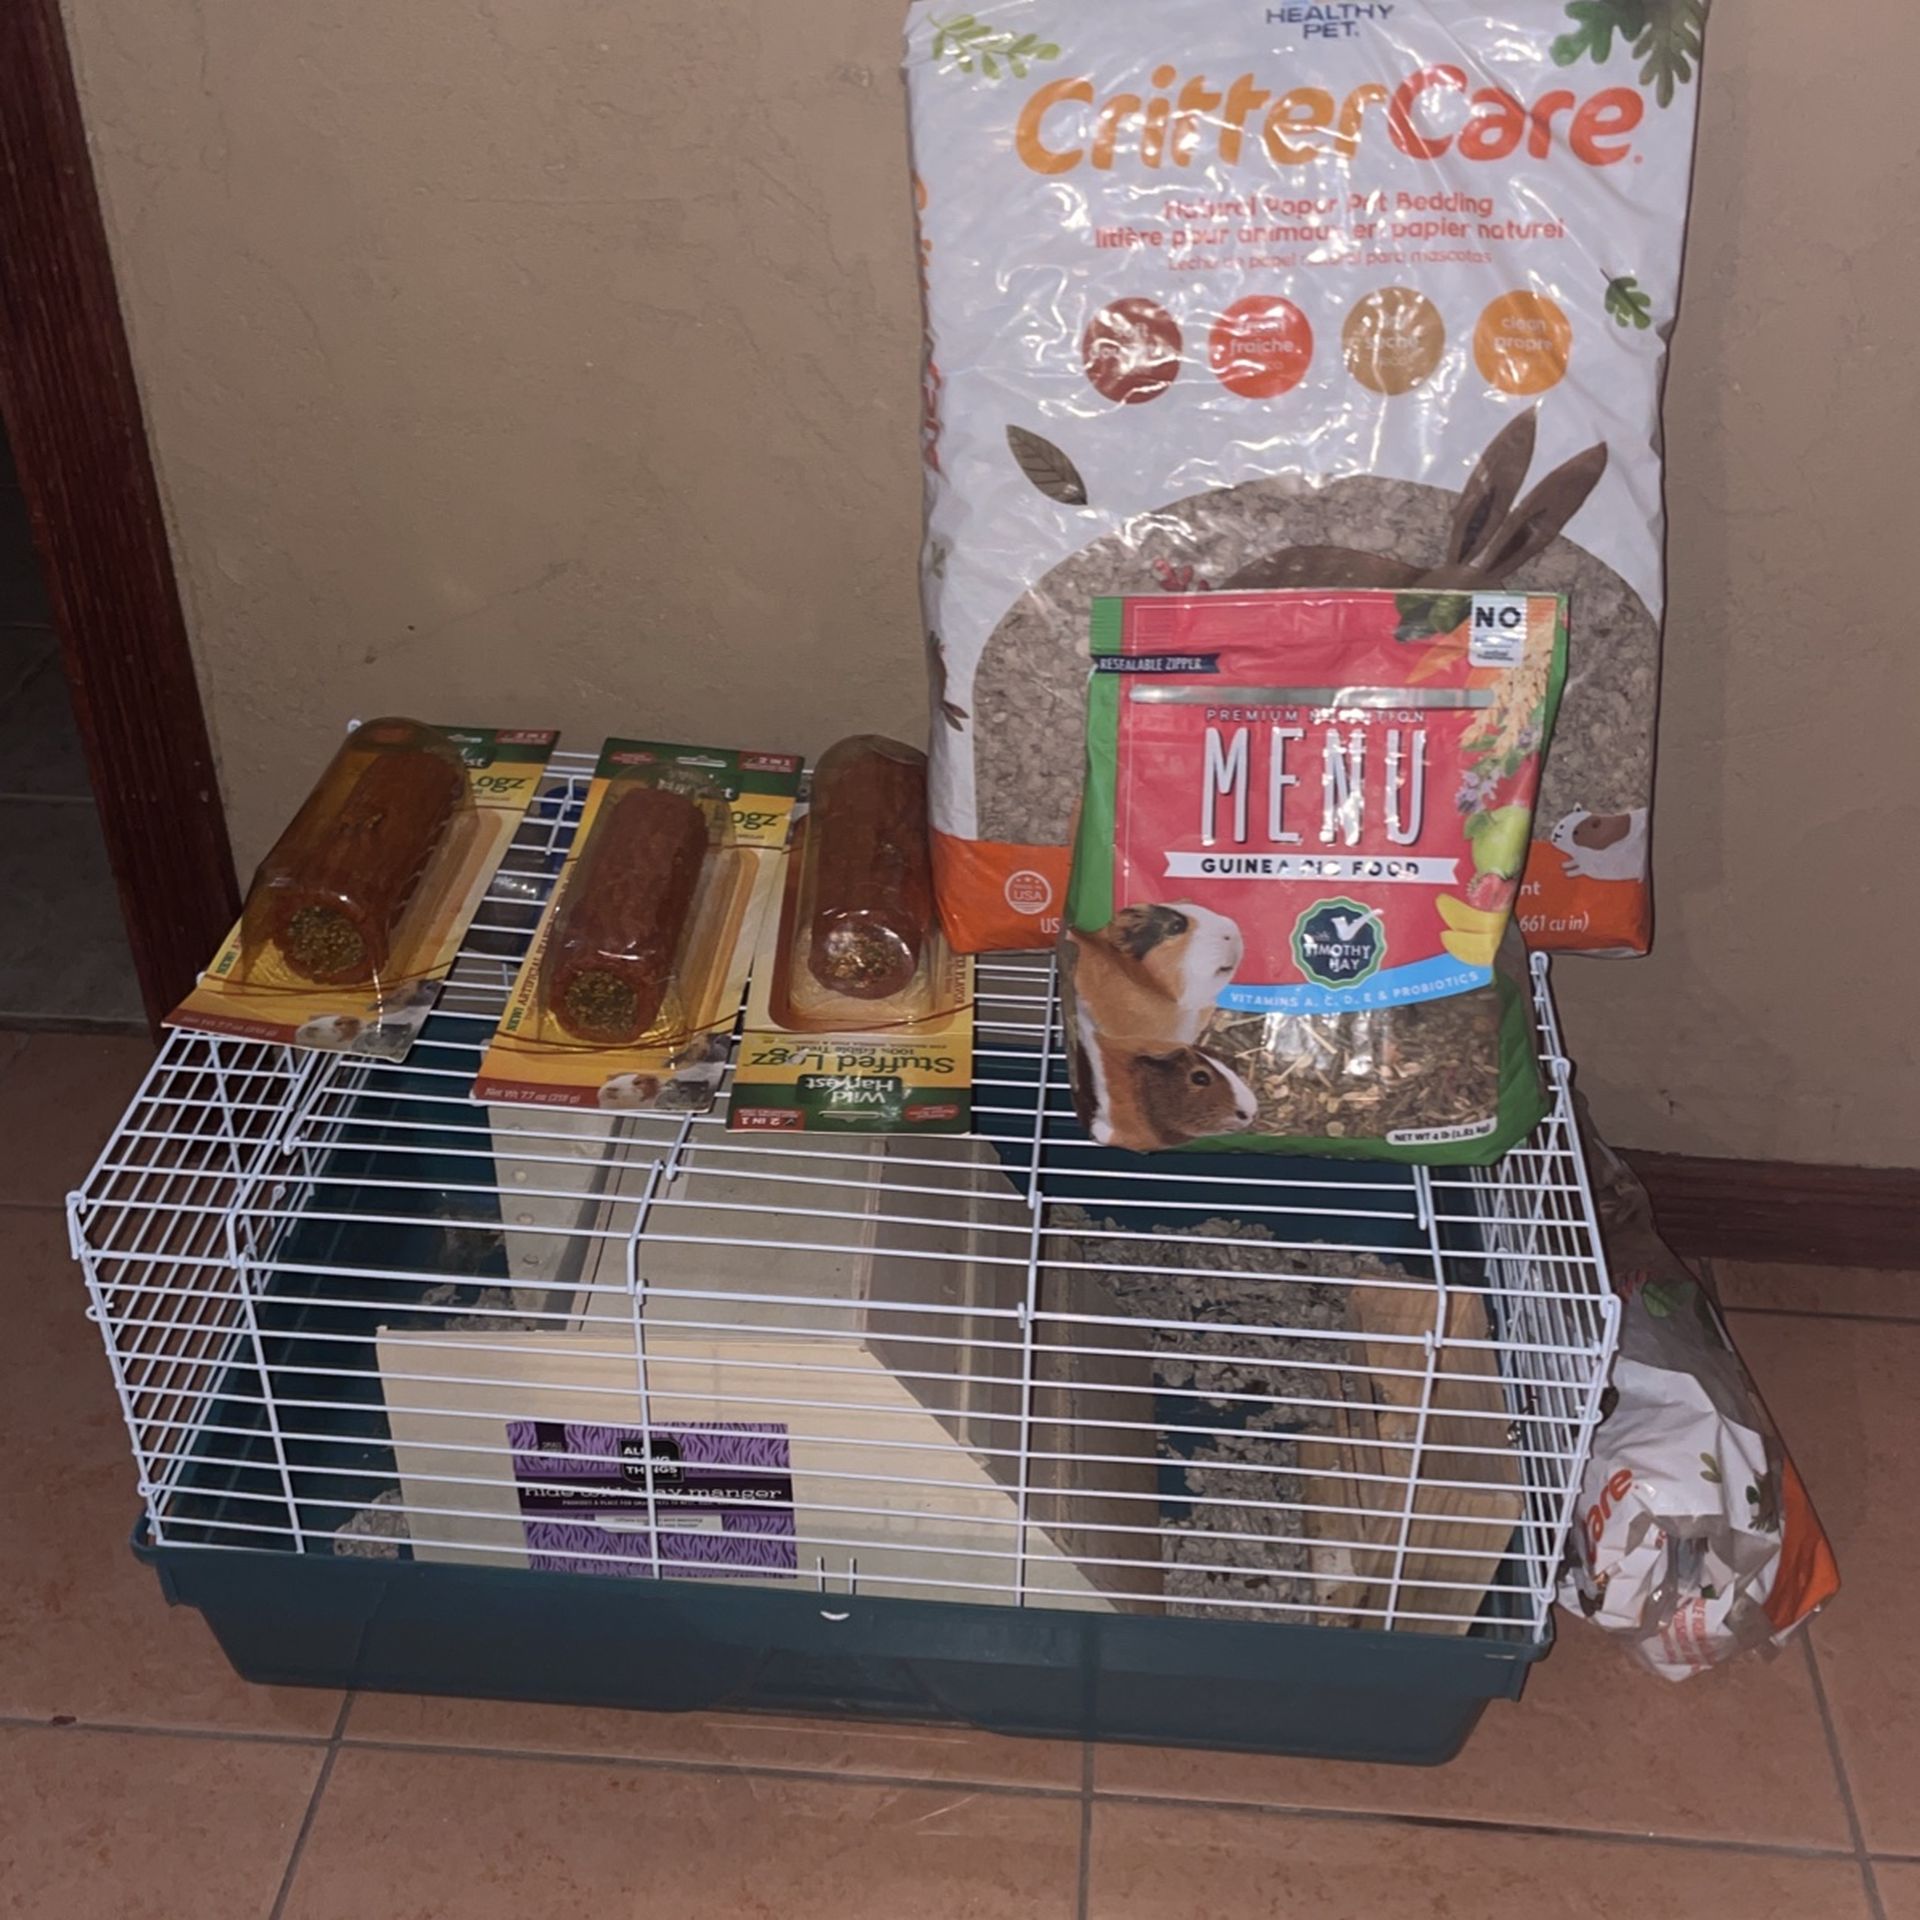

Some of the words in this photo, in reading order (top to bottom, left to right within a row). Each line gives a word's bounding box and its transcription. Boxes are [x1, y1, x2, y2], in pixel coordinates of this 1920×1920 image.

[1266, 3, 1394, 24] HEALTHY
[1347, 192, 1388, 213] Pt
[1396, 191, 1494, 217] Bedding
[1237, 225, 1341, 245] animau
[1391, 219, 1467, 241] papier
[1475, 605, 1522, 629] NO
[1100, 658, 1162, 672] RESEALABLE
[1165, 658, 1202, 671] ZIPPER
[1206, 709, 1299, 722] PREMIUM
[476, 776, 526, 794] ogz
[1201, 727, 1426, 847] MENU
[730, 811, 779, 831] ogz
[1200, 857, 1290, 875] GUINEA
[1351, 860, 1419, 877] FOOD
[1014, 890, 1042, 901] USA
[1549, 918, 1566, 932] cu
[1568, 910, 1590, 934] in)
[1303, 943, 1371, 960] TIMOTHY
[1329, 958, 1360, 973] HAY
[1229, 991, 1300, 1008] VITAMINS
[1393, 971, 1480, 998] PROBIOTICS
[837, 1054, 955, 1075] Stuffed
[806, 1076, 894, 1093] Harvest
[830, 1090, 886, 1105] Wild
[1394, 1133, 1413, 1141] NET
[1415, 1132, 1431, 1140] WT
[626, 1464, 678, 1474] THNGS
[688, 1488, 782, 1501] manger
